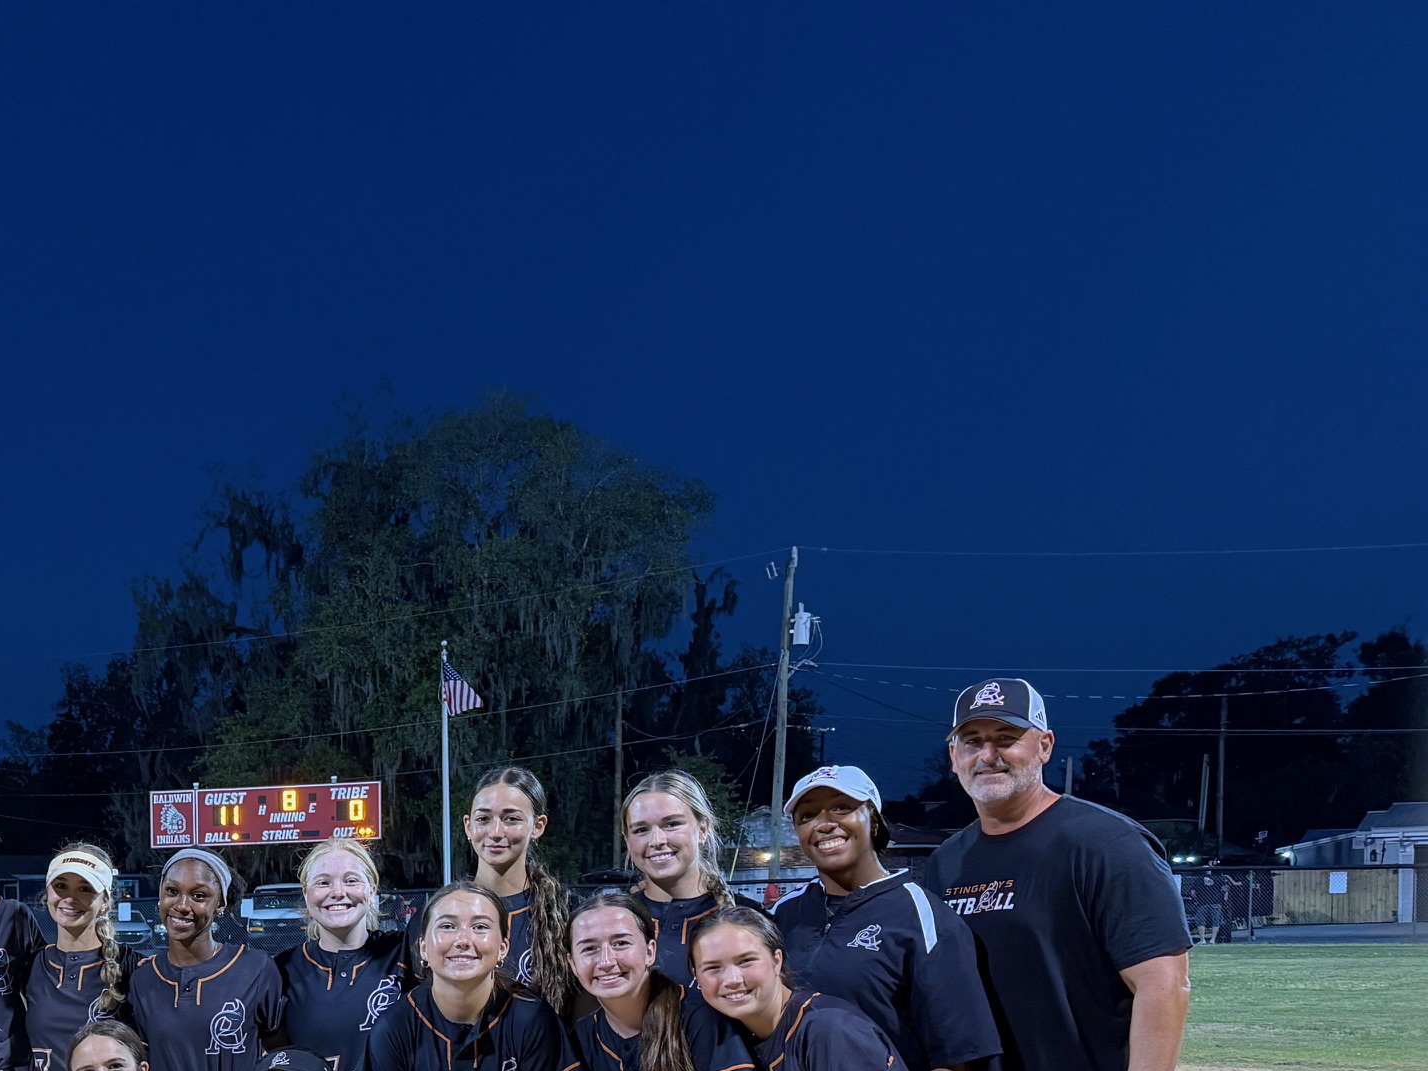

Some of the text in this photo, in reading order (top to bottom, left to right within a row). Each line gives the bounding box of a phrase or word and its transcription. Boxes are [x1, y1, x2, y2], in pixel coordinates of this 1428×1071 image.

[205, 792, 246, 805] GUEST
[330, 786, 369, 799] TRIBE
[153, 794, 192, 804] BALDWIN
[282, 790, 296, 811] 8
[258, 805, 267, 815] H
[309, 803, 317, 813] E
[349, 800, 364, 821] 0
[220, 805, 239, 826] 11
[269, 811, 306, 823] INNING
[205, 832, 231, 843] BALL
[262, 829, 300, 841] STRIKE
[333, 827, 355, 838] OUT
[156, 834, 191, 844] INDIANS
